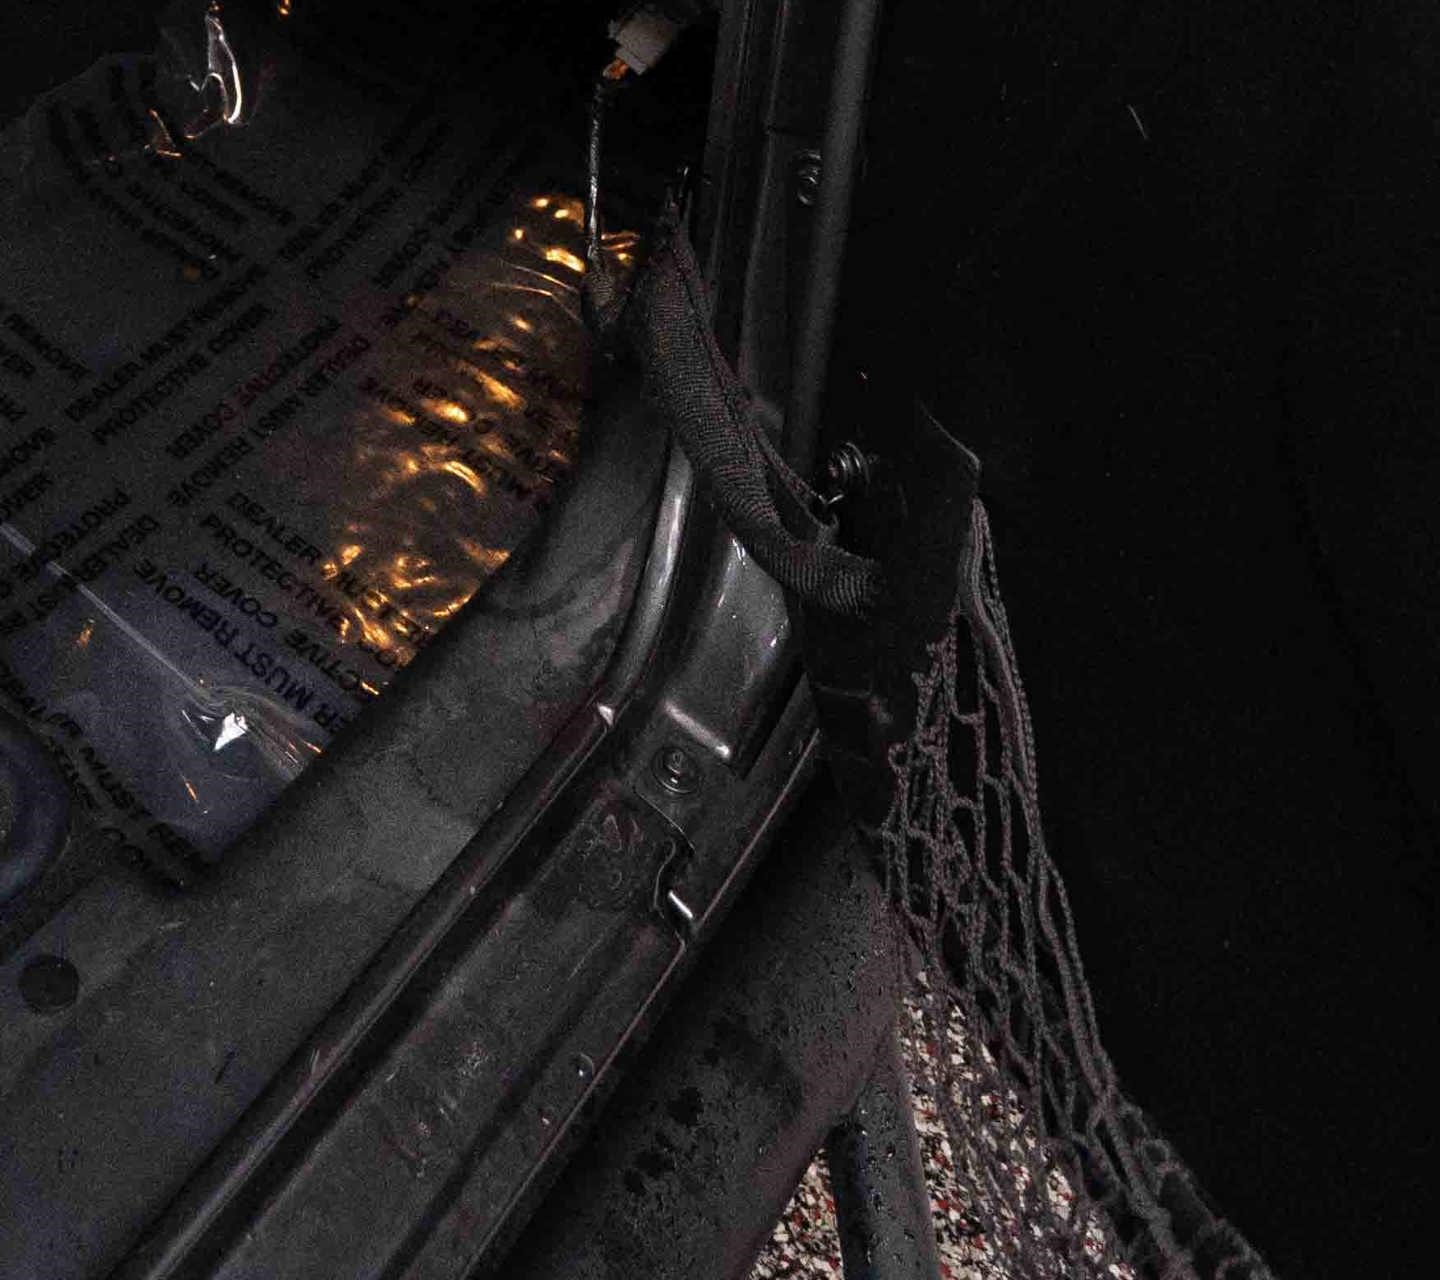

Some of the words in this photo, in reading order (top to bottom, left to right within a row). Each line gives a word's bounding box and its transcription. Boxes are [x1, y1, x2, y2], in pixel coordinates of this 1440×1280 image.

[161, 431, 257, 513] REMOVE
[162, 397, 240, 465] COVER
[225, 485, 324, 569] DEALER
[129, 555, 241, 650] REMOVE
[191, 558, 281, 635] COVER
[197, 507, 353, 636] PROTECTIVE
[233, 638, 316, 711] MUST
